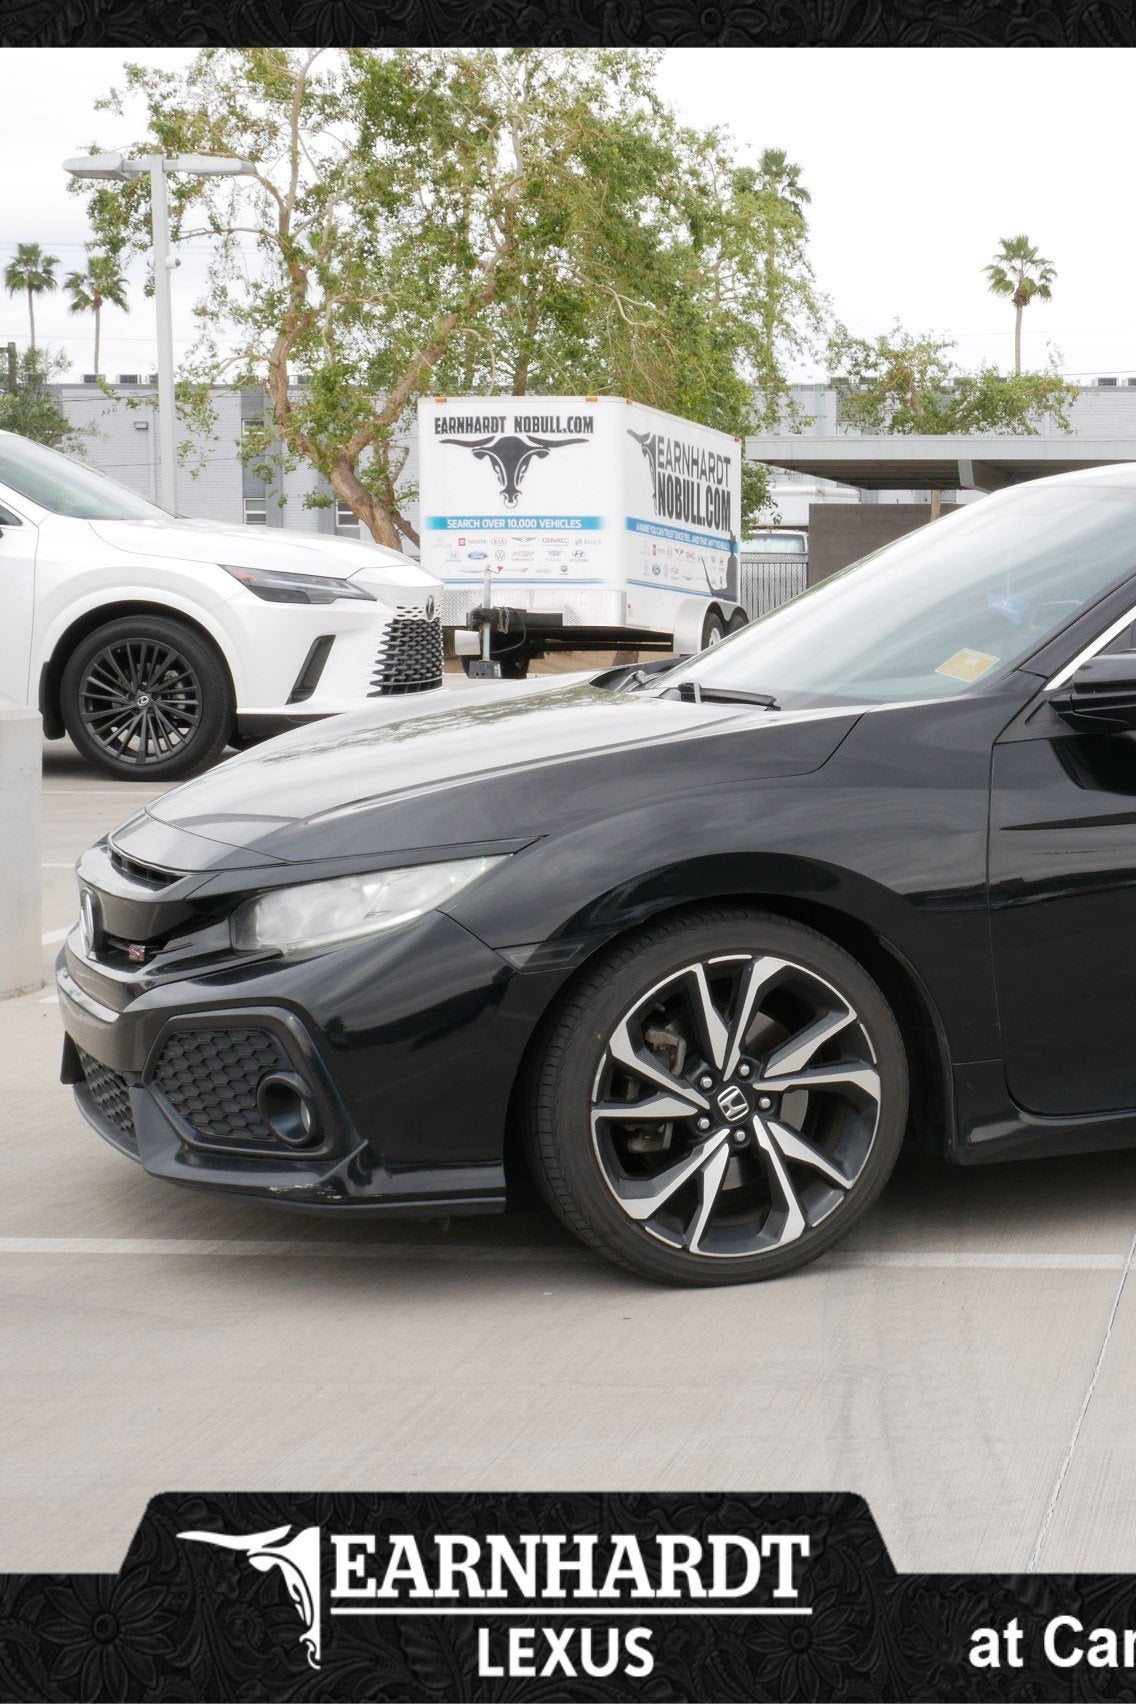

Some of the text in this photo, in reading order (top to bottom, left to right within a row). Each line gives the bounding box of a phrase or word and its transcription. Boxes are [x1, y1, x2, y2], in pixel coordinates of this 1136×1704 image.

[434, 415, 594, 434] EARNHARDT NOBULL.COM
[657, 435, 731, 487] EARNHARDT
[657, 470, 731, 532] NOBULL.COM
[447, 519, 582, 529] SEARCH OVER 10,000 VEHICLES
